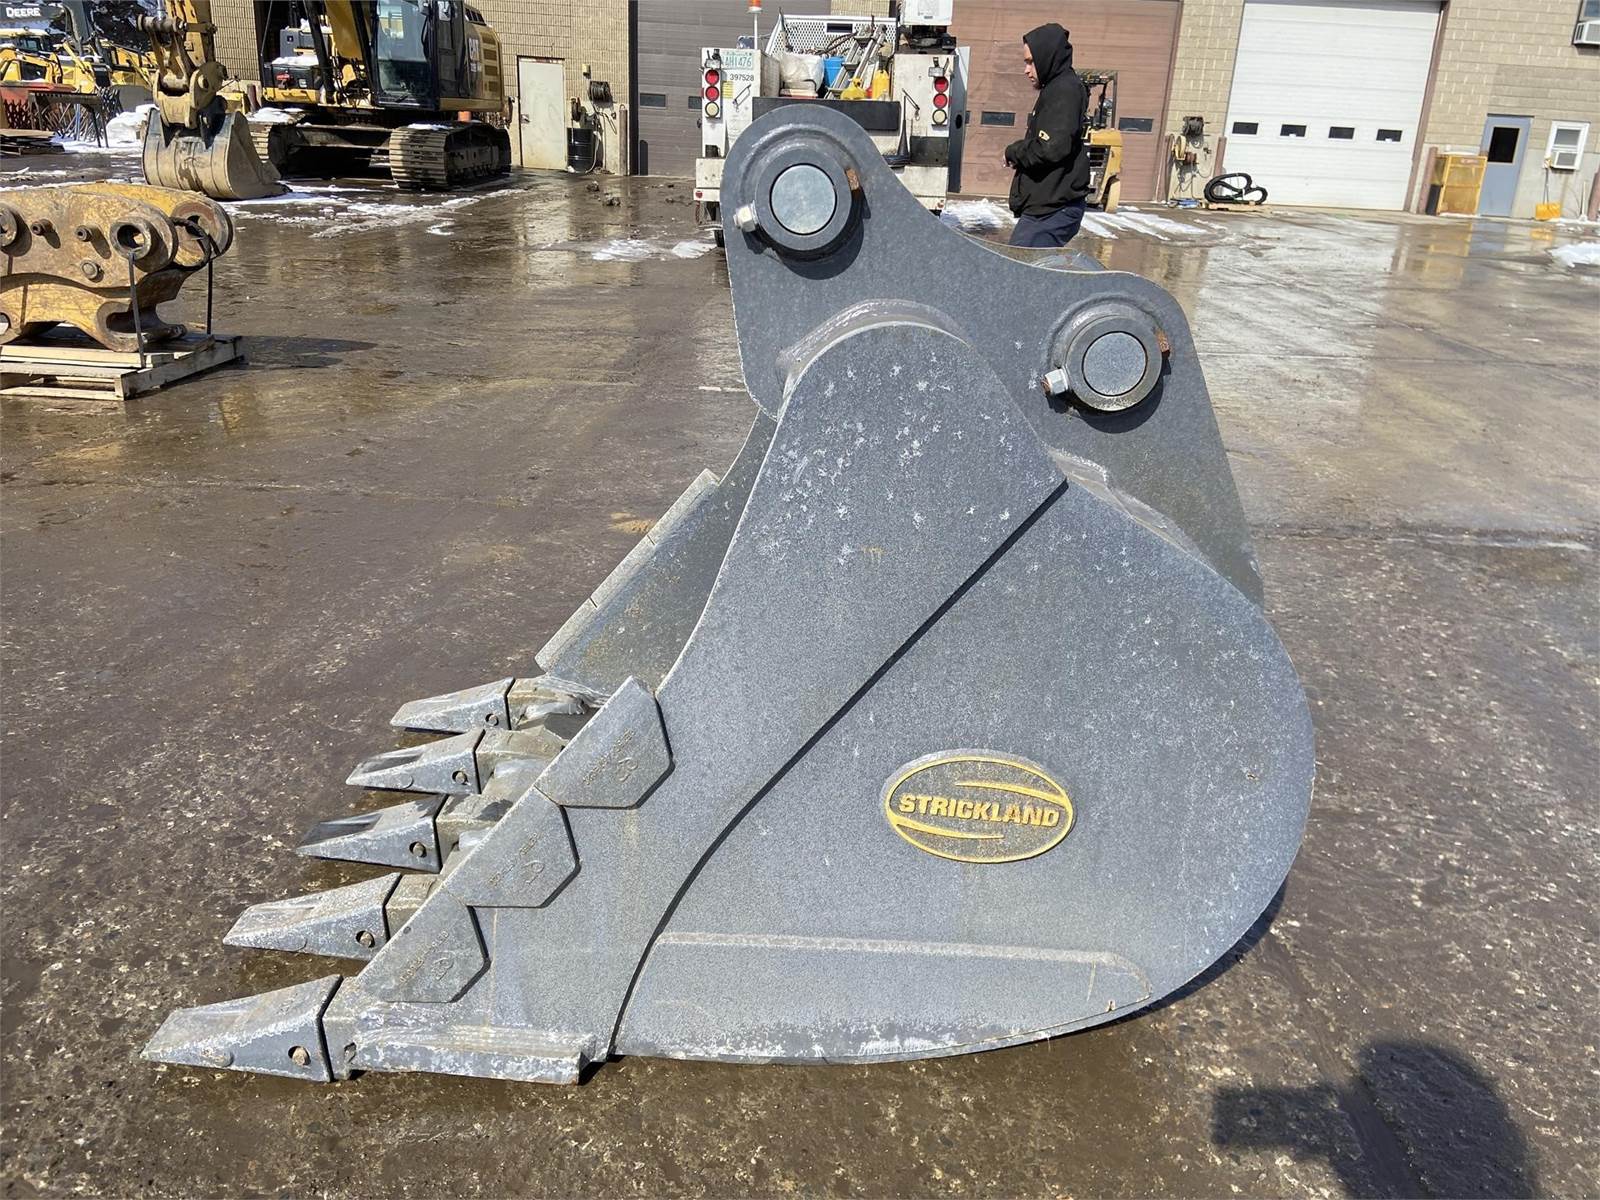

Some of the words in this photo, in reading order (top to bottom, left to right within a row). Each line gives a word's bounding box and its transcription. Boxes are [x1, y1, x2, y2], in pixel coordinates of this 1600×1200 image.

[5, 6, 42, 18] DEERE
[729, 73, 755, 82] 397528
[899, 793, 1061, 828] STRICKLAND
